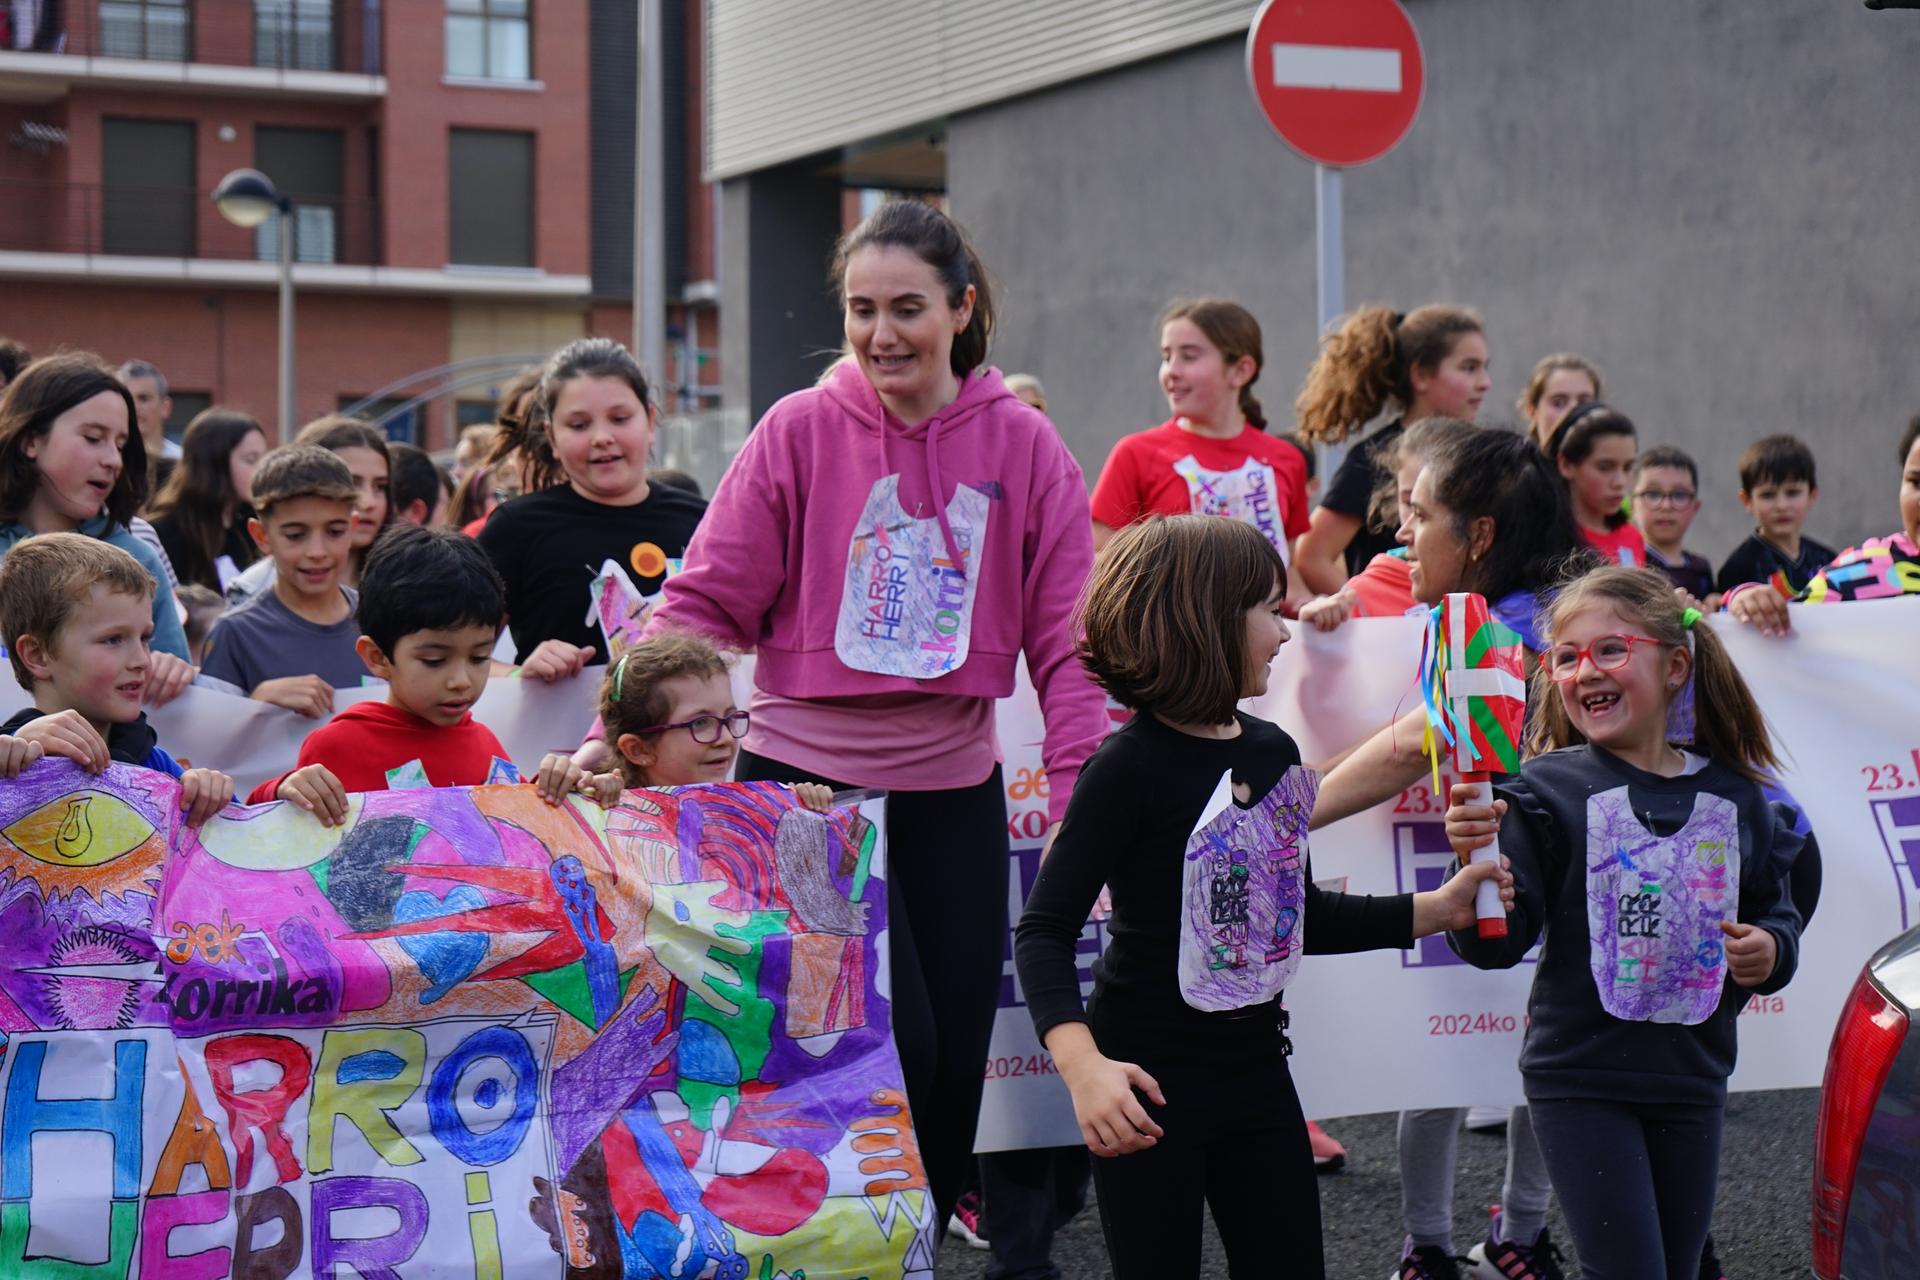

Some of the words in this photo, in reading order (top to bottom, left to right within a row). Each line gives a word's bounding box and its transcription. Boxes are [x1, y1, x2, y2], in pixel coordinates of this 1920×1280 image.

[1244, 471, 1277, 545] orrika
[862, 544, 892, 638] HARRO
[880, 554, 910, 641] HERRI
[1008, 767, 1049, 800] ae
[1428, 1011, 1516, 1035] 2024ko
[1741, 994, 1784, 1014] 4ra
[984, 1054, 1058, 1079] 2024k
[2, 1024, 540, 1199] HARRO
